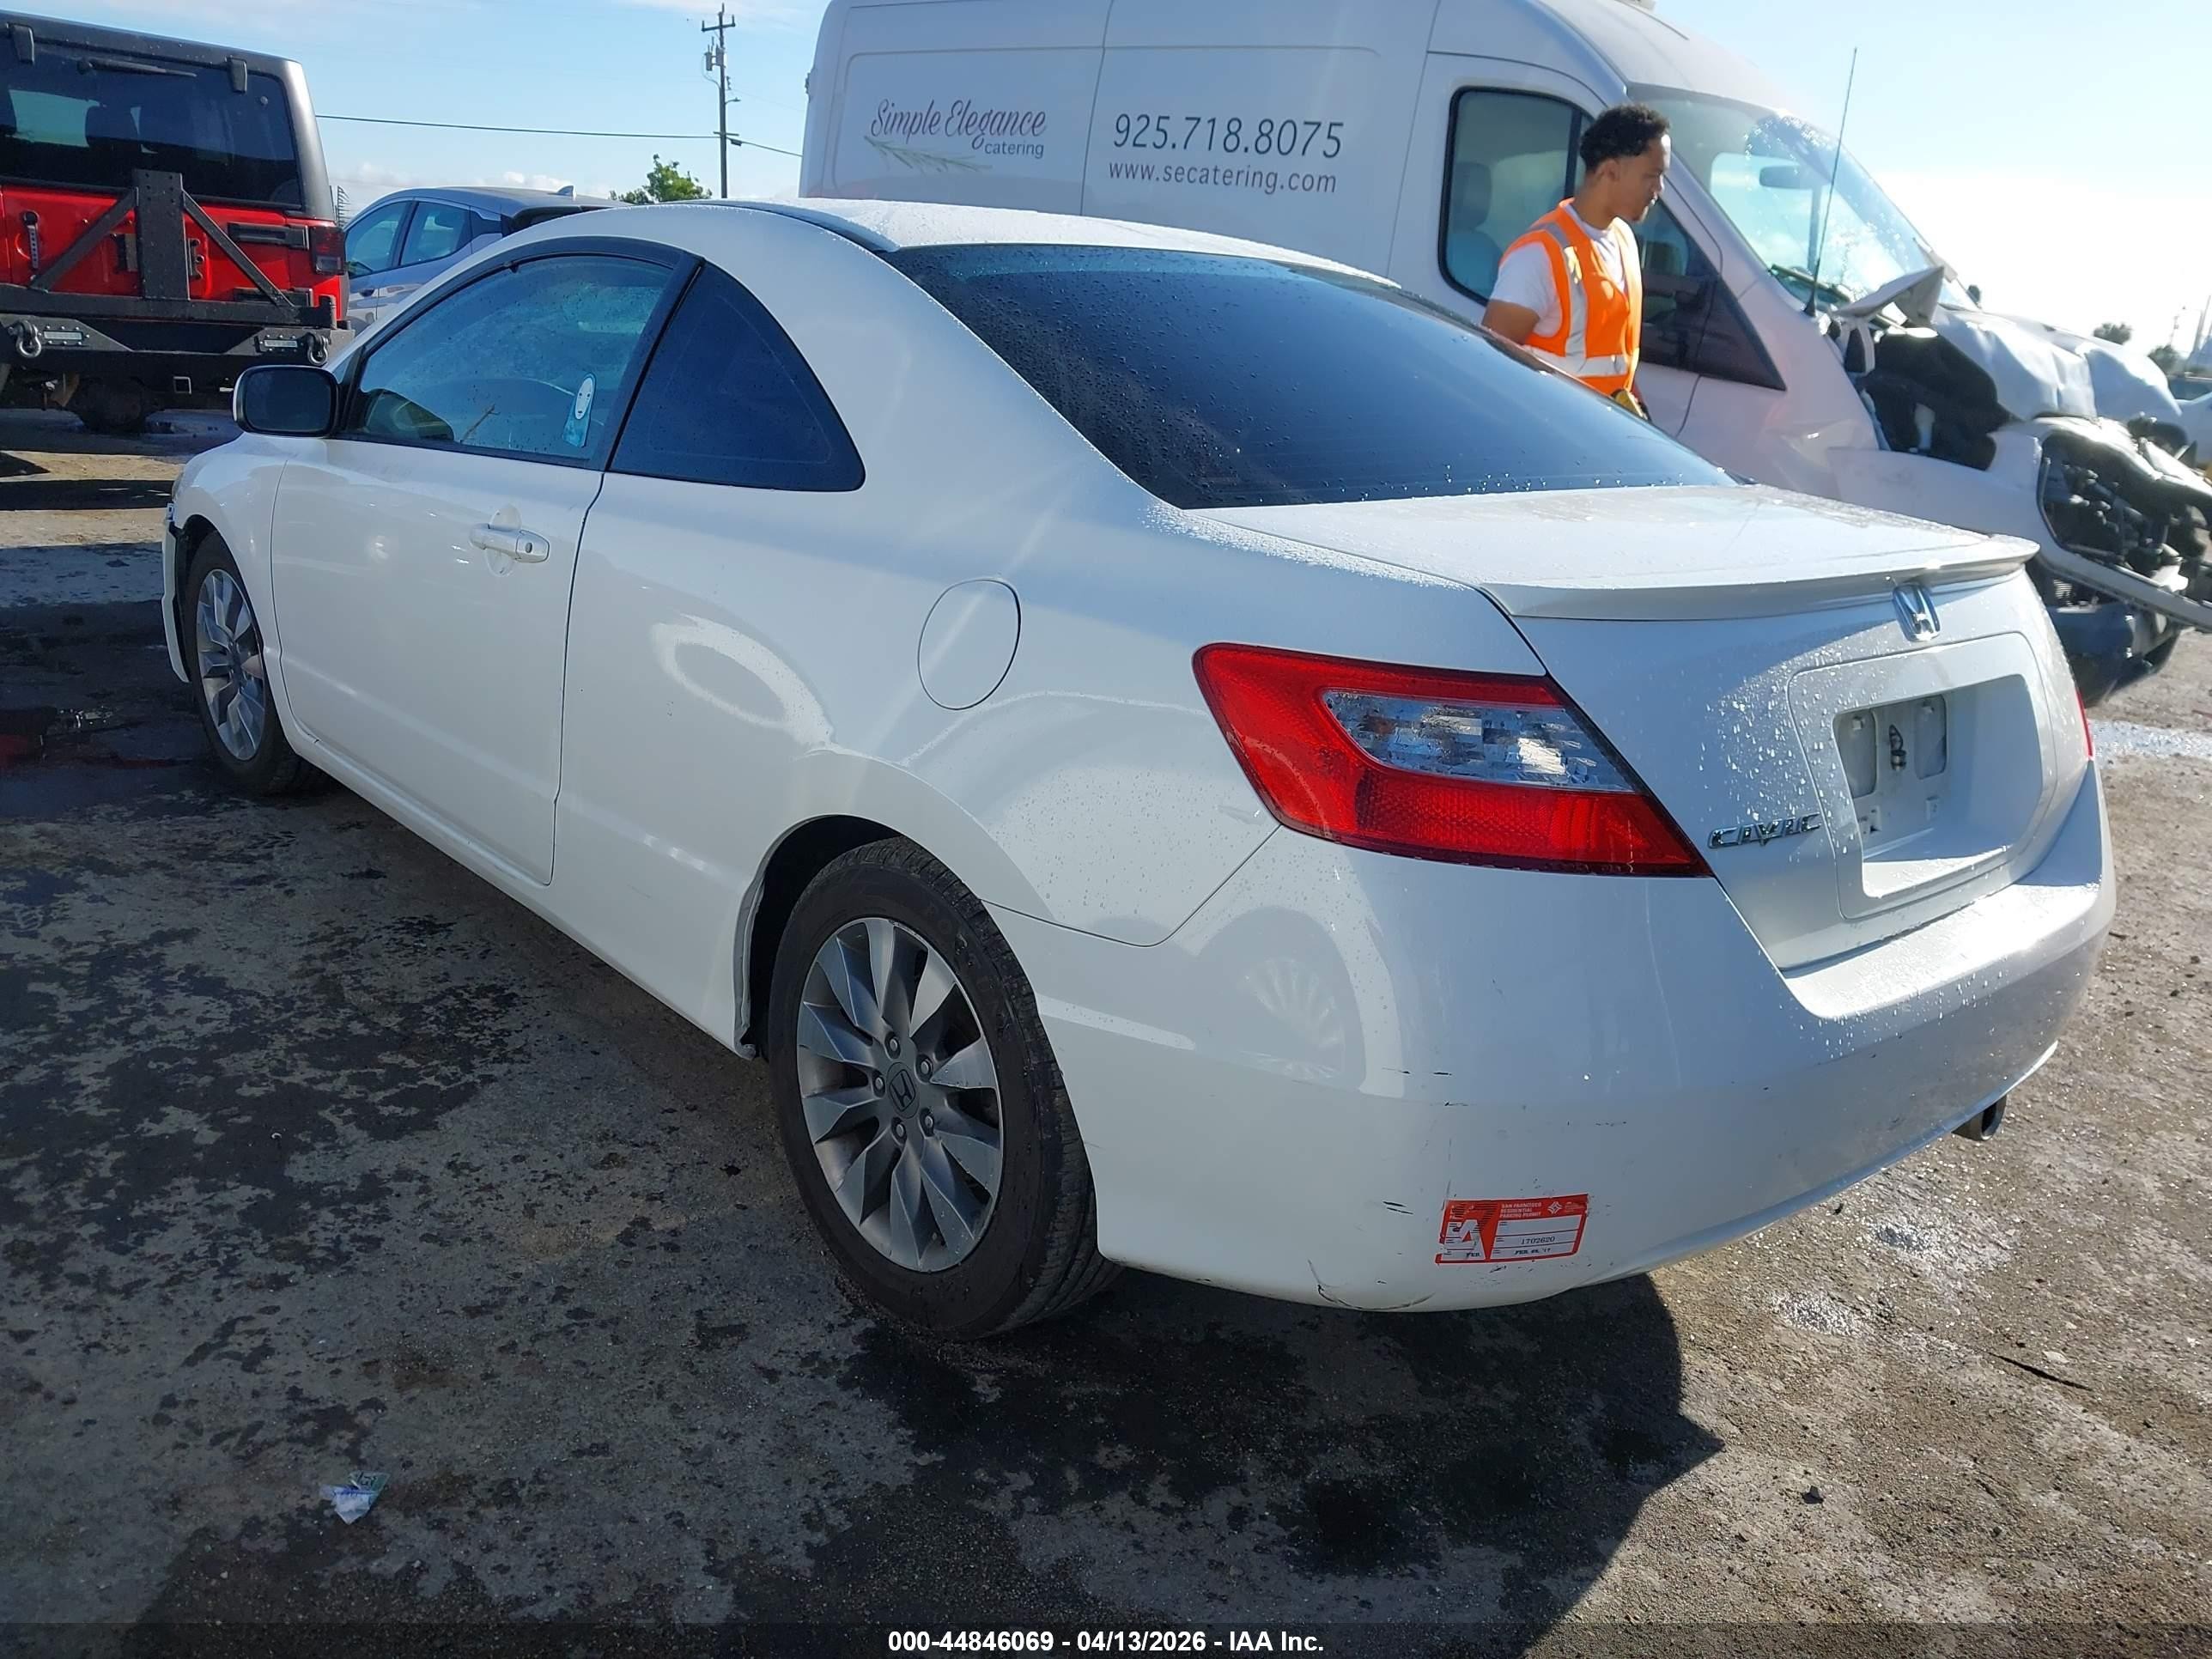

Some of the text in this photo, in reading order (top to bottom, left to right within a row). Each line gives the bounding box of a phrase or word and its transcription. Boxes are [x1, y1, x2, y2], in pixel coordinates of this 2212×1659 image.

[871, 98, 1047, 149] Simple Elegance
[1113, 113, 1345, 159] 925.718.8075
[984, 140, 1045, 159] catering
[1109, 161, 1337, 195] www.secatering.com
[1707, 811, 1822, 850] CIVIC
